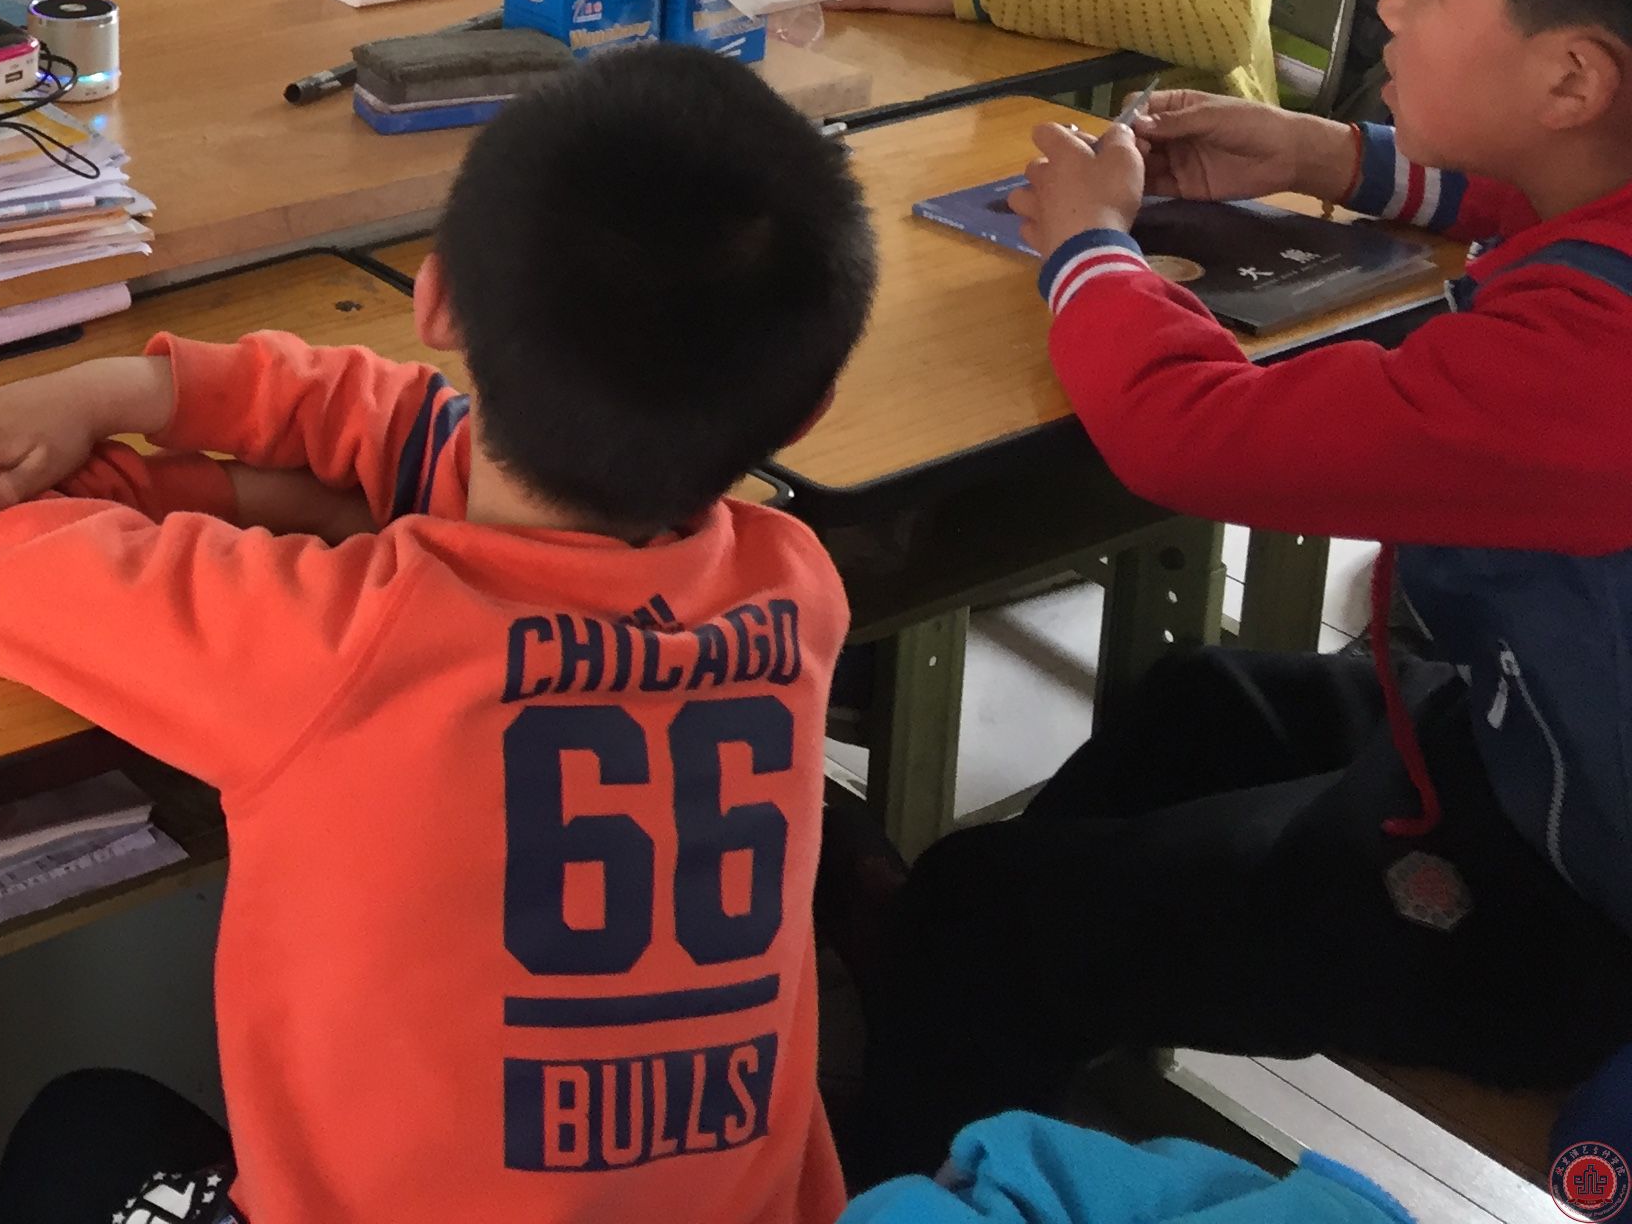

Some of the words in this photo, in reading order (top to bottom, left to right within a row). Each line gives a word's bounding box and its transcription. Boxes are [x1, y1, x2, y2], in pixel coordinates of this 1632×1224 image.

[502, 595, 803, 703] CHICAGO
[503, 695, 795, 976] 66
[542, 1042, 760, 1167] BULLS
